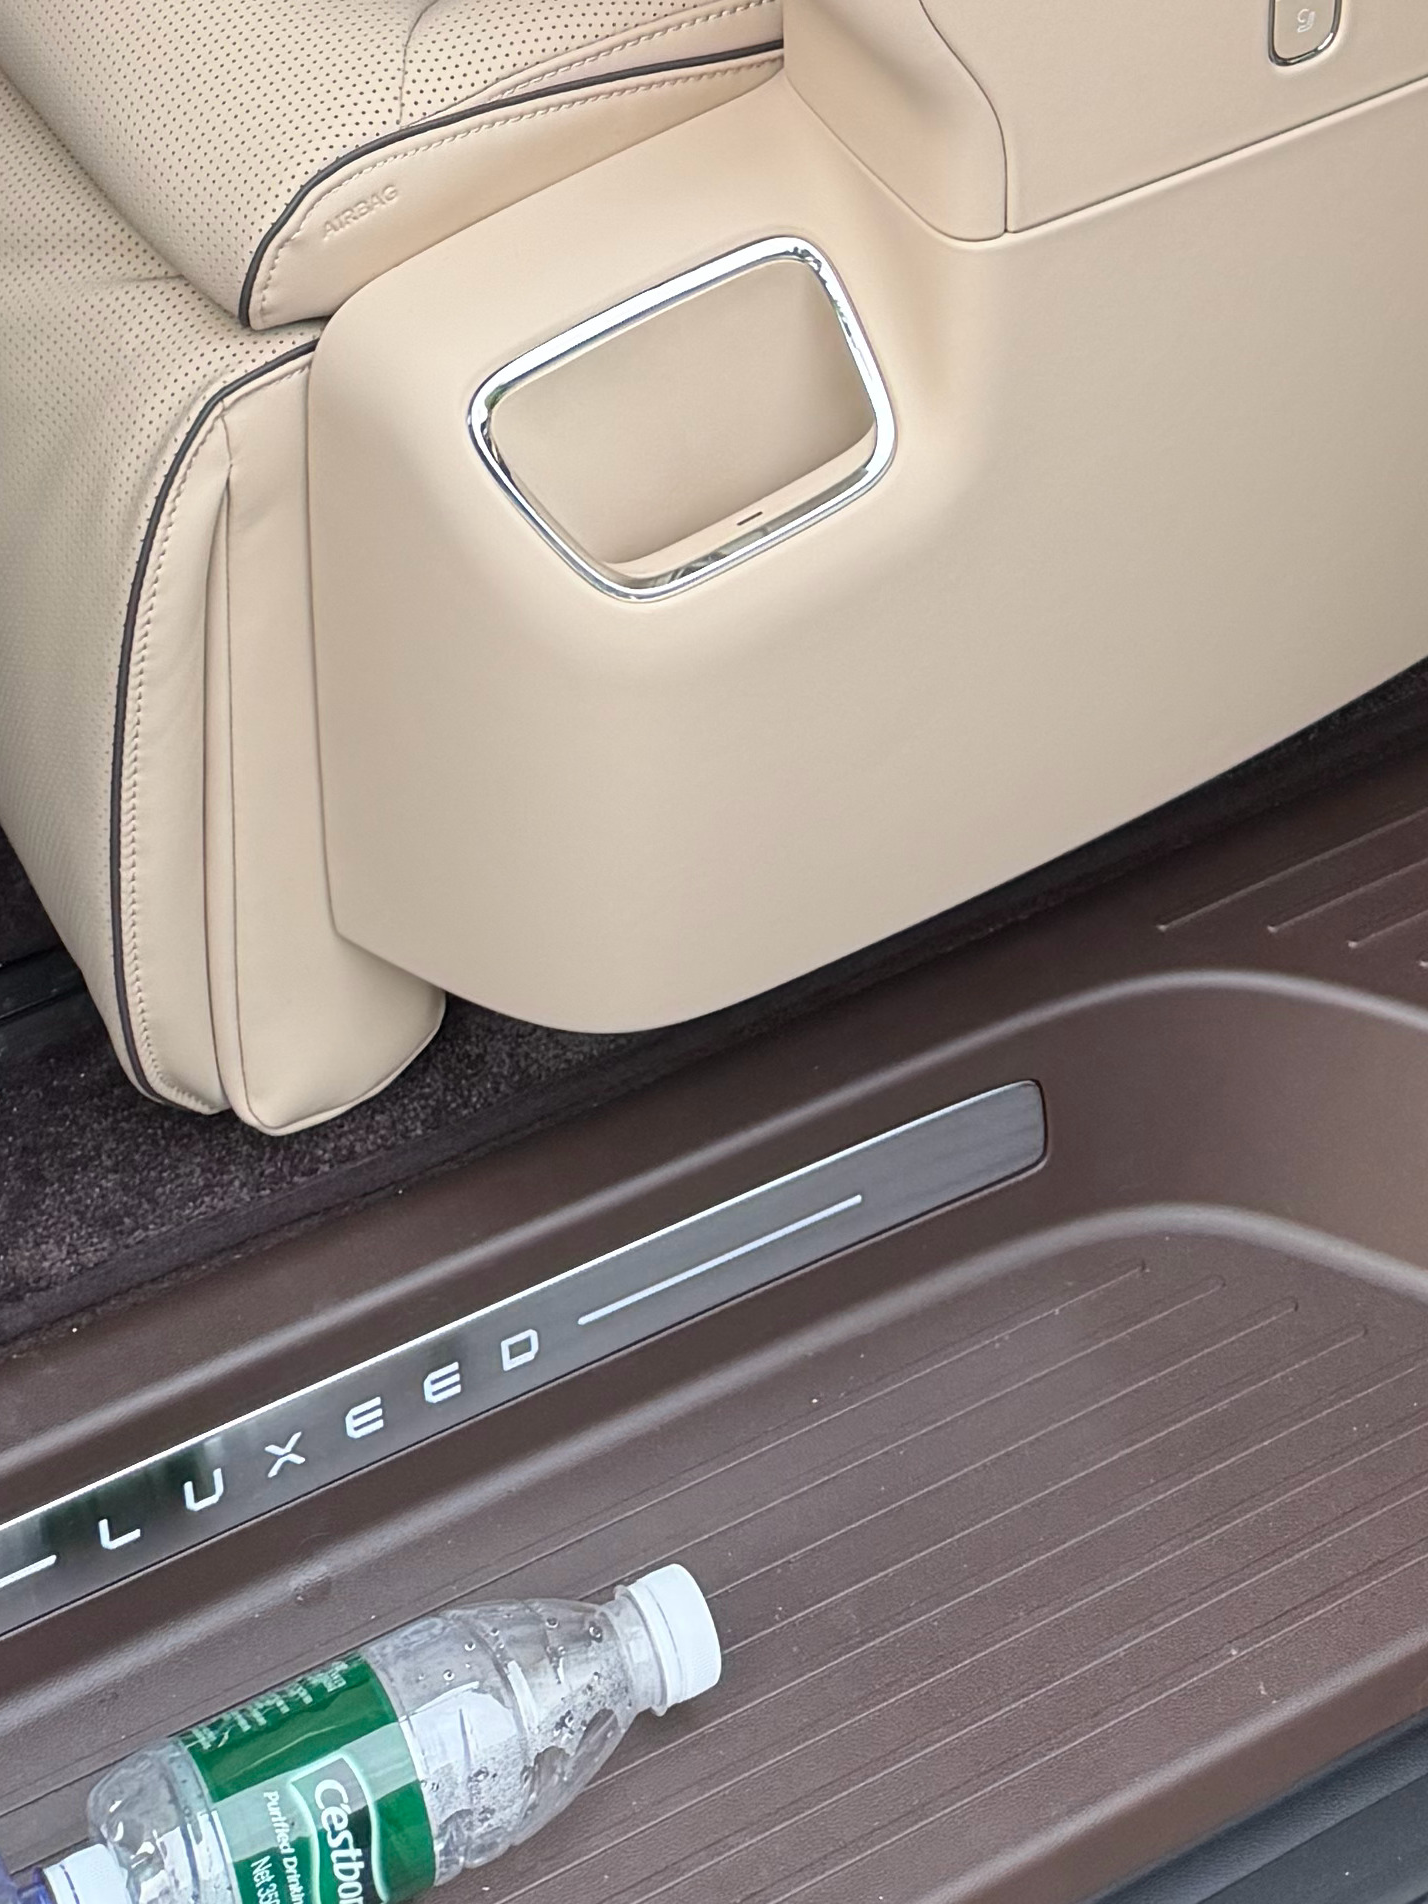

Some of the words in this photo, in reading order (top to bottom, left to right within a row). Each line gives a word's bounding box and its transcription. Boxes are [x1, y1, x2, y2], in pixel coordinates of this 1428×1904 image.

[323, 184, 398, 237] AIRBAG
[98, 1328, 540, 1550] LUXEED
[263, 1790, 296, 1855] Purified
[250, 1855, 275, 1888] Net
